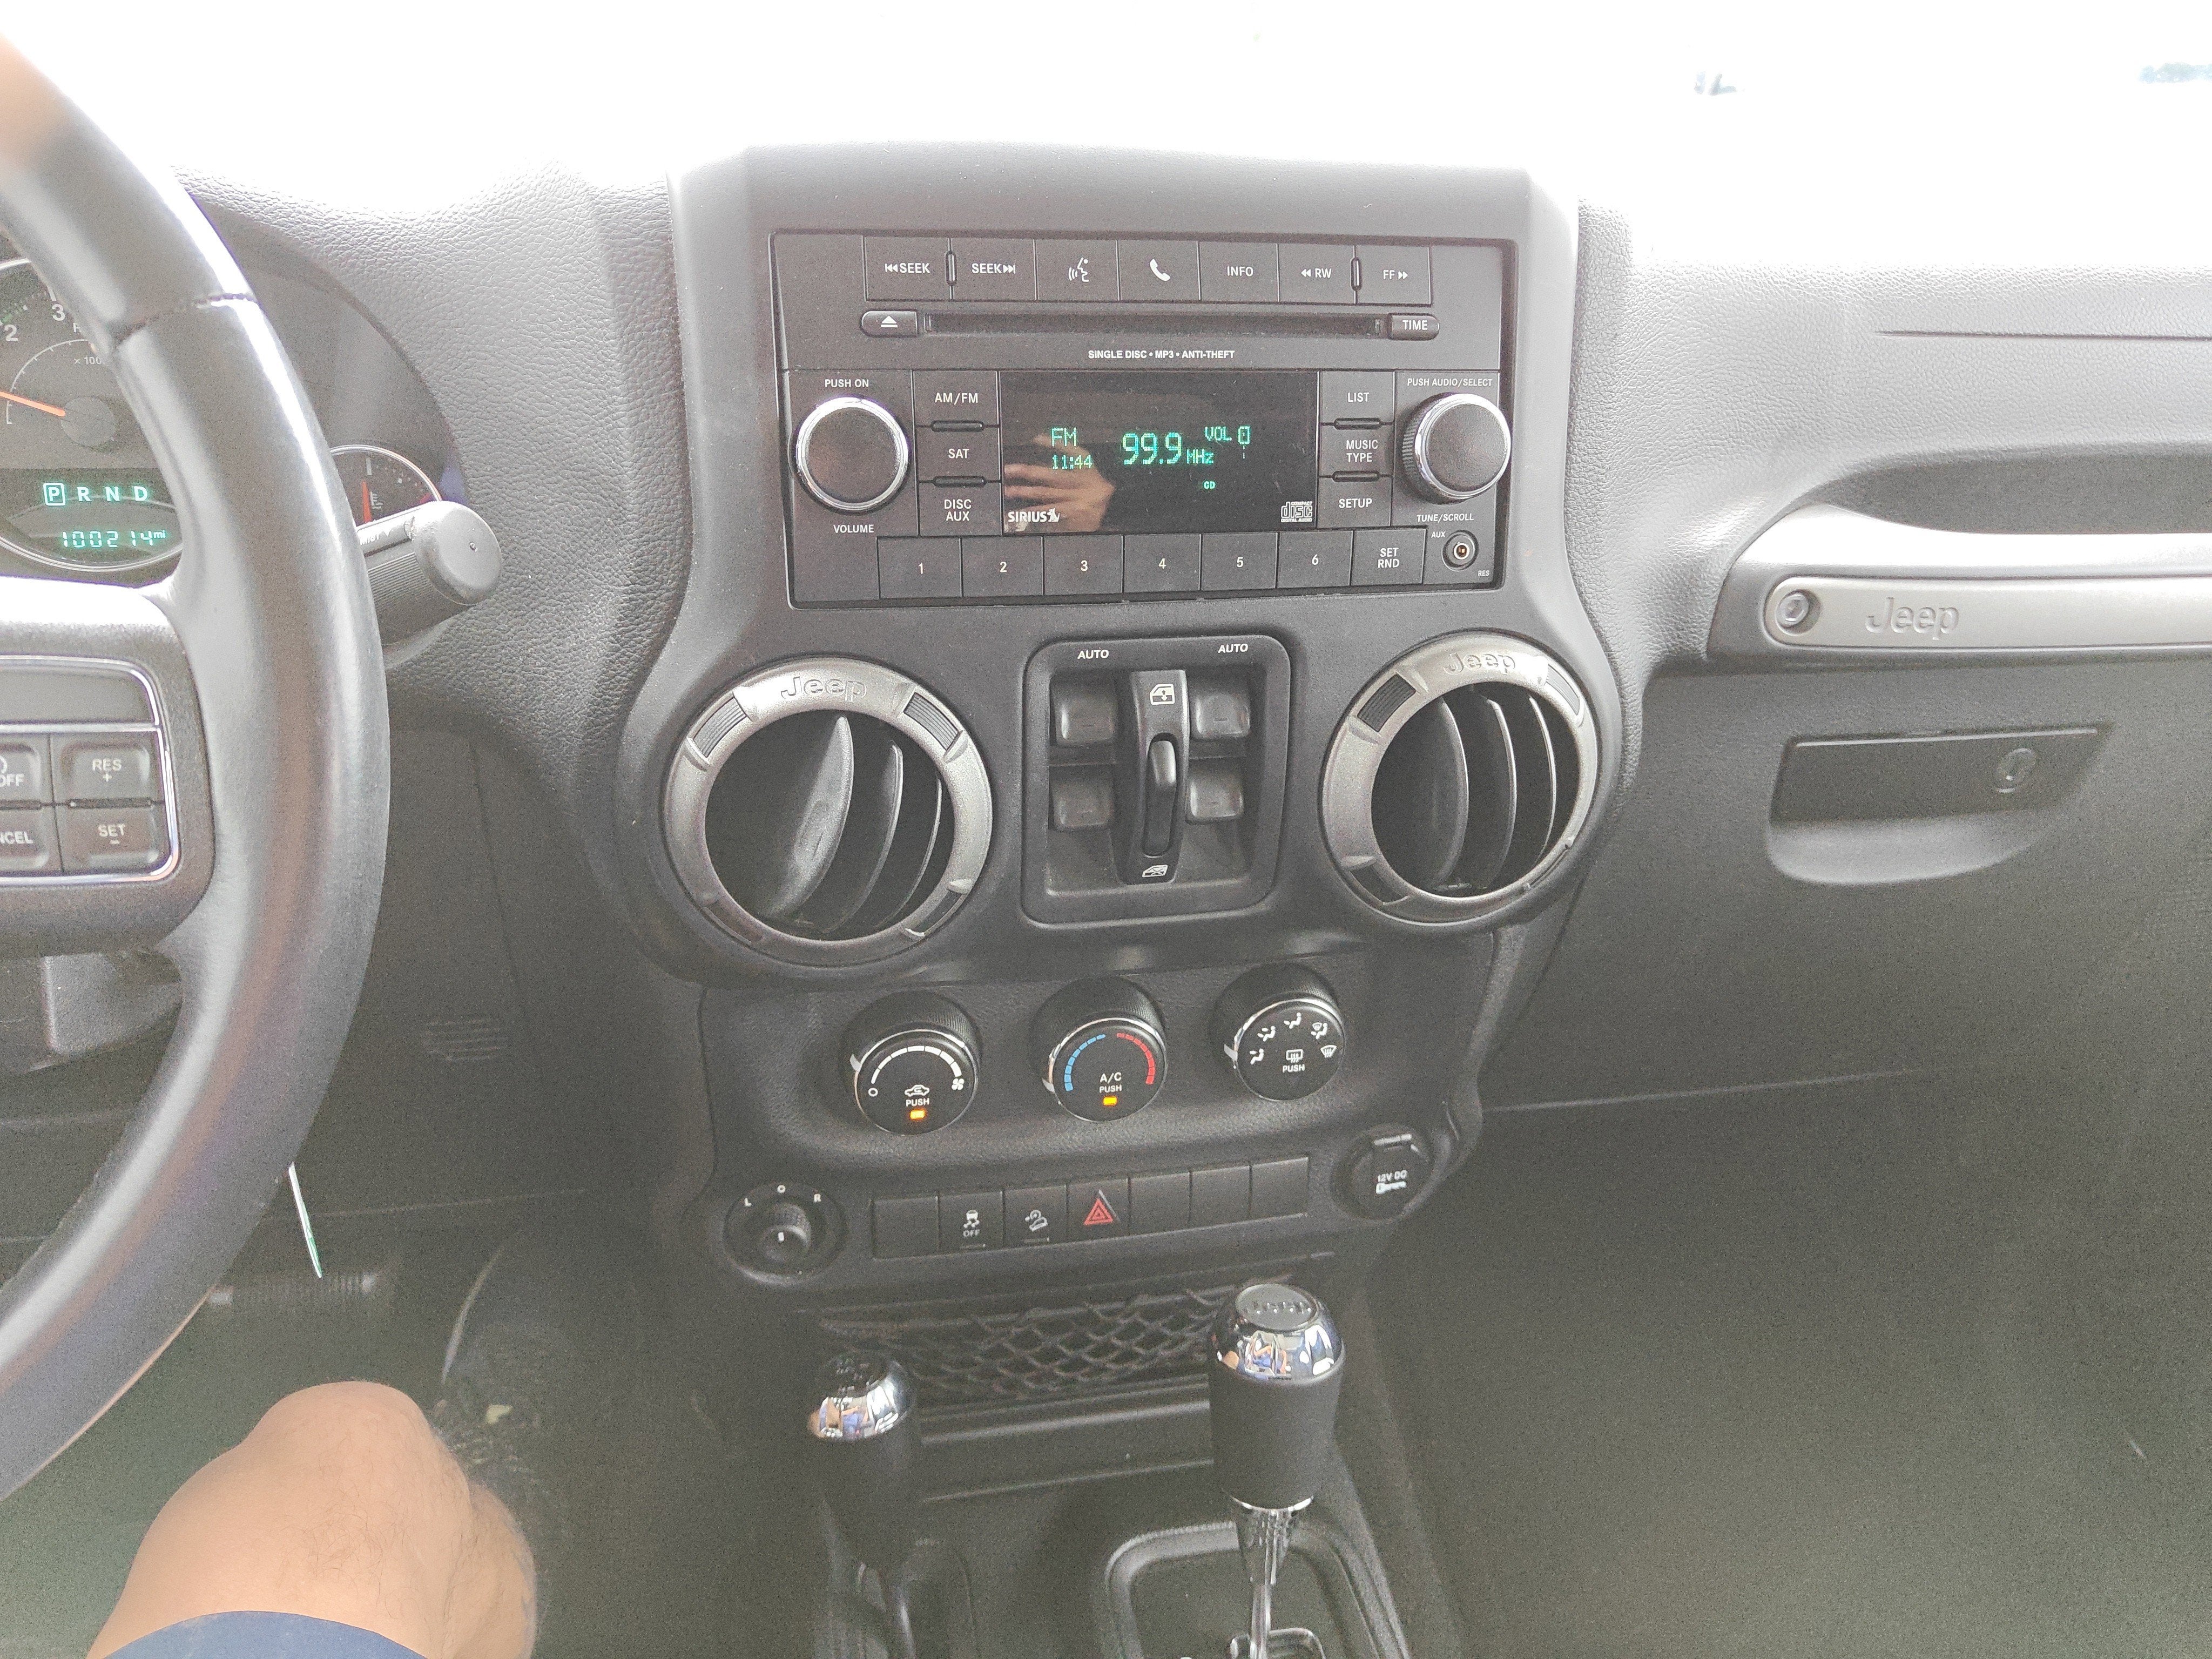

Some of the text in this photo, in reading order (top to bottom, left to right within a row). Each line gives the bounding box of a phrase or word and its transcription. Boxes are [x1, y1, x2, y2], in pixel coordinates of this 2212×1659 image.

[899, 262, 930, 274] SEEK
[972, 263, 1001, 274] SEEK
[1227, 266, 1253, 276] INFO
[1315, 268, 1332, 278] RW
[1383, 269, 1395, 280] FF
[51, 304, 65, 321] 3
[1402, 319, 1428, 331] TIME
[4, 324, 19, 342] 2
[1088, 350, 1235, 359] SINGLE DISC MP3 ANTI-THEFT
[825, 379, 869, 388] PUSH ON
[1407, 377, 1493, 388] PUSH AUDIO/SELECT
[934, 392, 978, 406] AM/FM
[1347, 392, 1370, 402] LIST
[1050, 427, 1077, 447] FM
[1205, 426, 1232, 441] VOL
[1122, 433, 1214, 465] 99.9 MHz
[1346, 439, 1378, 450] MUSIC
[948, 448, 970, 459] SAT
[1346, 452, 1372, 463] TYPE
[1050, 454, 1093, 470] 11:44
[1204, 480, 1216, 489] CD
[48, 485, 149, 502] P R N D
[944, 498, 972, 509] DISC
[1338, 498, 1372, 509] SETUP
[946, 510, 970, 522] AUX
[1008, 510, 1047, 524] SIRIUS
[1417, 513, 1474, 523] TUNE/SCROLL
[833, 524, 874, 534] VOLUME
[1380, 547, 1399, 557] SET
[1158, 558, 1166, 569] 4
[1236, 556, 1244, 568] 5
[1311, 554, 1319, 565] 6
[1378, 558, 1400, 569] RND
[919, 563, 923, 575] 1
[1000, 561, 1007, 573] 2
[1080, 560, 1088, 571] 3
[1865, 597, 1959, 640] Jeep
[1218, 643, 1249, 653] AUTO
[1077, 649, 1109, 659] AUTO
[1443, 652, 1515, 675] Jeep
[781, 676, 867, 702] Jeep
[92, 758, 122, 771] RES
[98, 824, 126, 838] SET
[1282, 1064, 1306, 1074] PUSH
[1100, 1071, 1122, 1084] A/C
[1099, 1084, 1122, 1094] PUSH
[906, 1097, 930, 1107] PUSH
[813, 1193, 821, 1203] R
[963, 1229, 980, 1237] OFF
